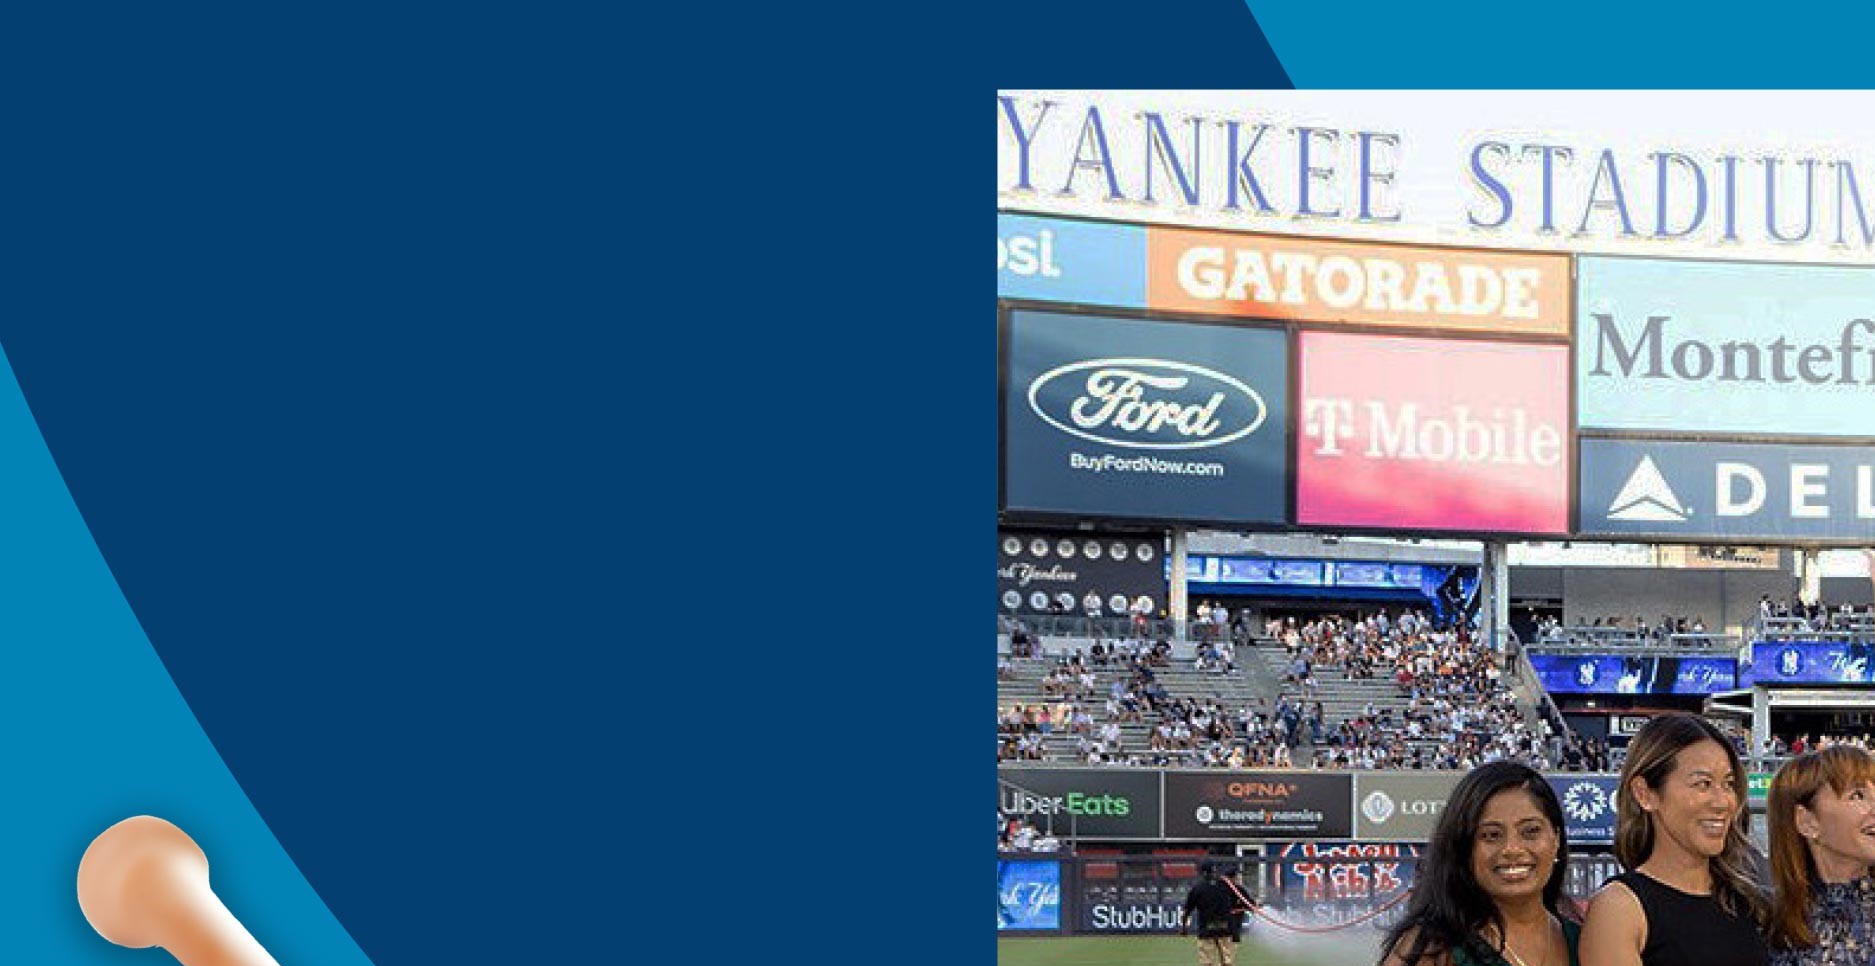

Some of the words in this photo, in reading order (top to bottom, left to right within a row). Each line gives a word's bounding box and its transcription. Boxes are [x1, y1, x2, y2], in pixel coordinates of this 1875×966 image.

[998, 95, 1401, 222] YANKEE
[1176, 245, 1541, 319] GATORADE
[1070, 367, 1225, 437] Ford
[1070, 452, 1225, 477] BuyFordNow.com
[1002, 792, 1062, 814] Uber
[1067, 792, 1129, 815] Eats
